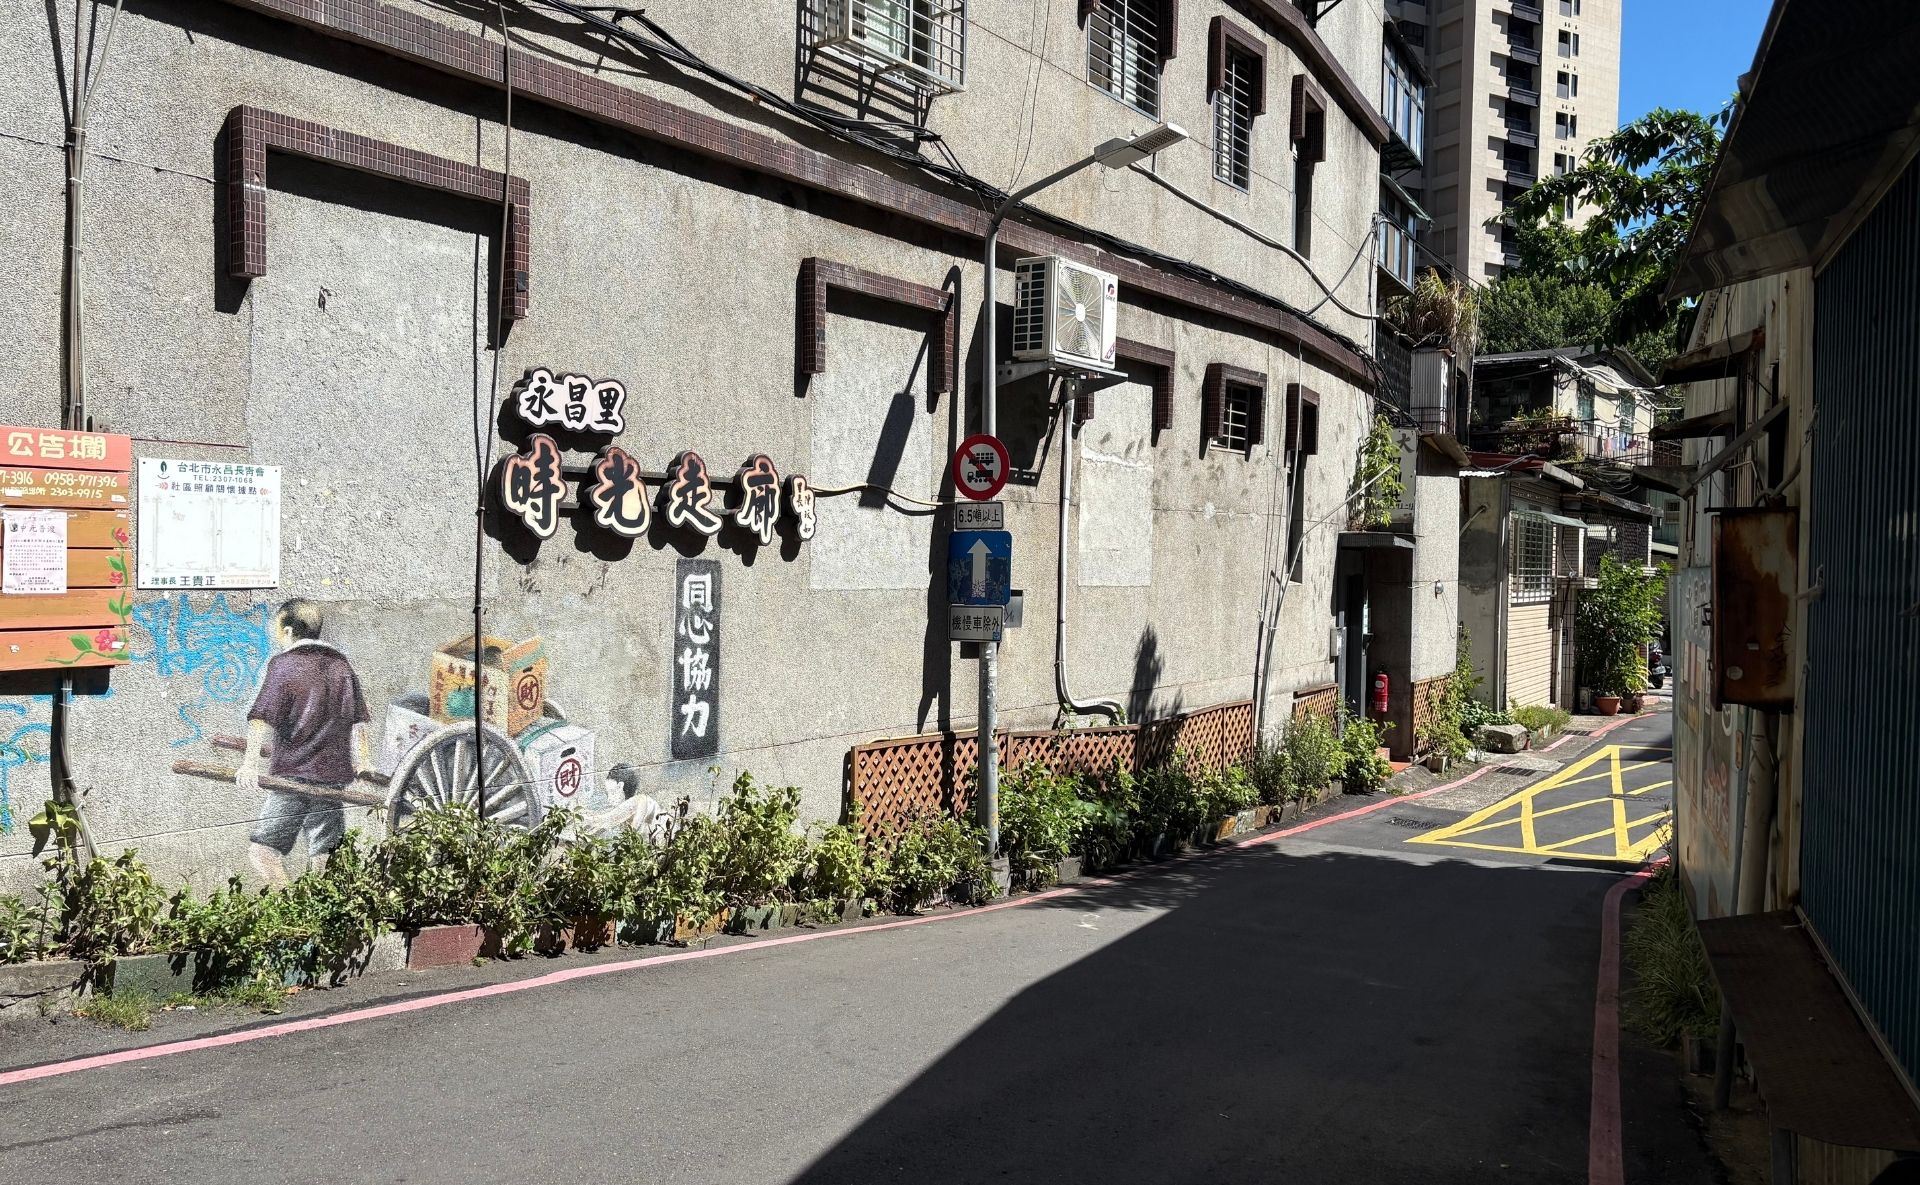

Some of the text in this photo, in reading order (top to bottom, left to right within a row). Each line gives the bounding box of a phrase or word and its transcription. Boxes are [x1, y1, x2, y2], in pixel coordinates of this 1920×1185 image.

[525, 377, 619, 426] 永昌里
[8, 432, 107, 460] 公告欄
[44, 472, 118, 488] 0958-971396
[194, 475, 253, 484] TEL:2307-1068
[51, 487, 104, 499] 2303-9915
[171, 483, 257, 495] 社區照顧關懷據點
[510, 443, 778, 534] 時光走廊
[958, 507, 1001, 524] 6.5噸以上
[150, 577, 177, 586] 理事長
[179, 575, 216, 587] 王貴正
[951, 615, 1000, 632] 機慢車除外
[678, 572, 714, 738] 同心協力
